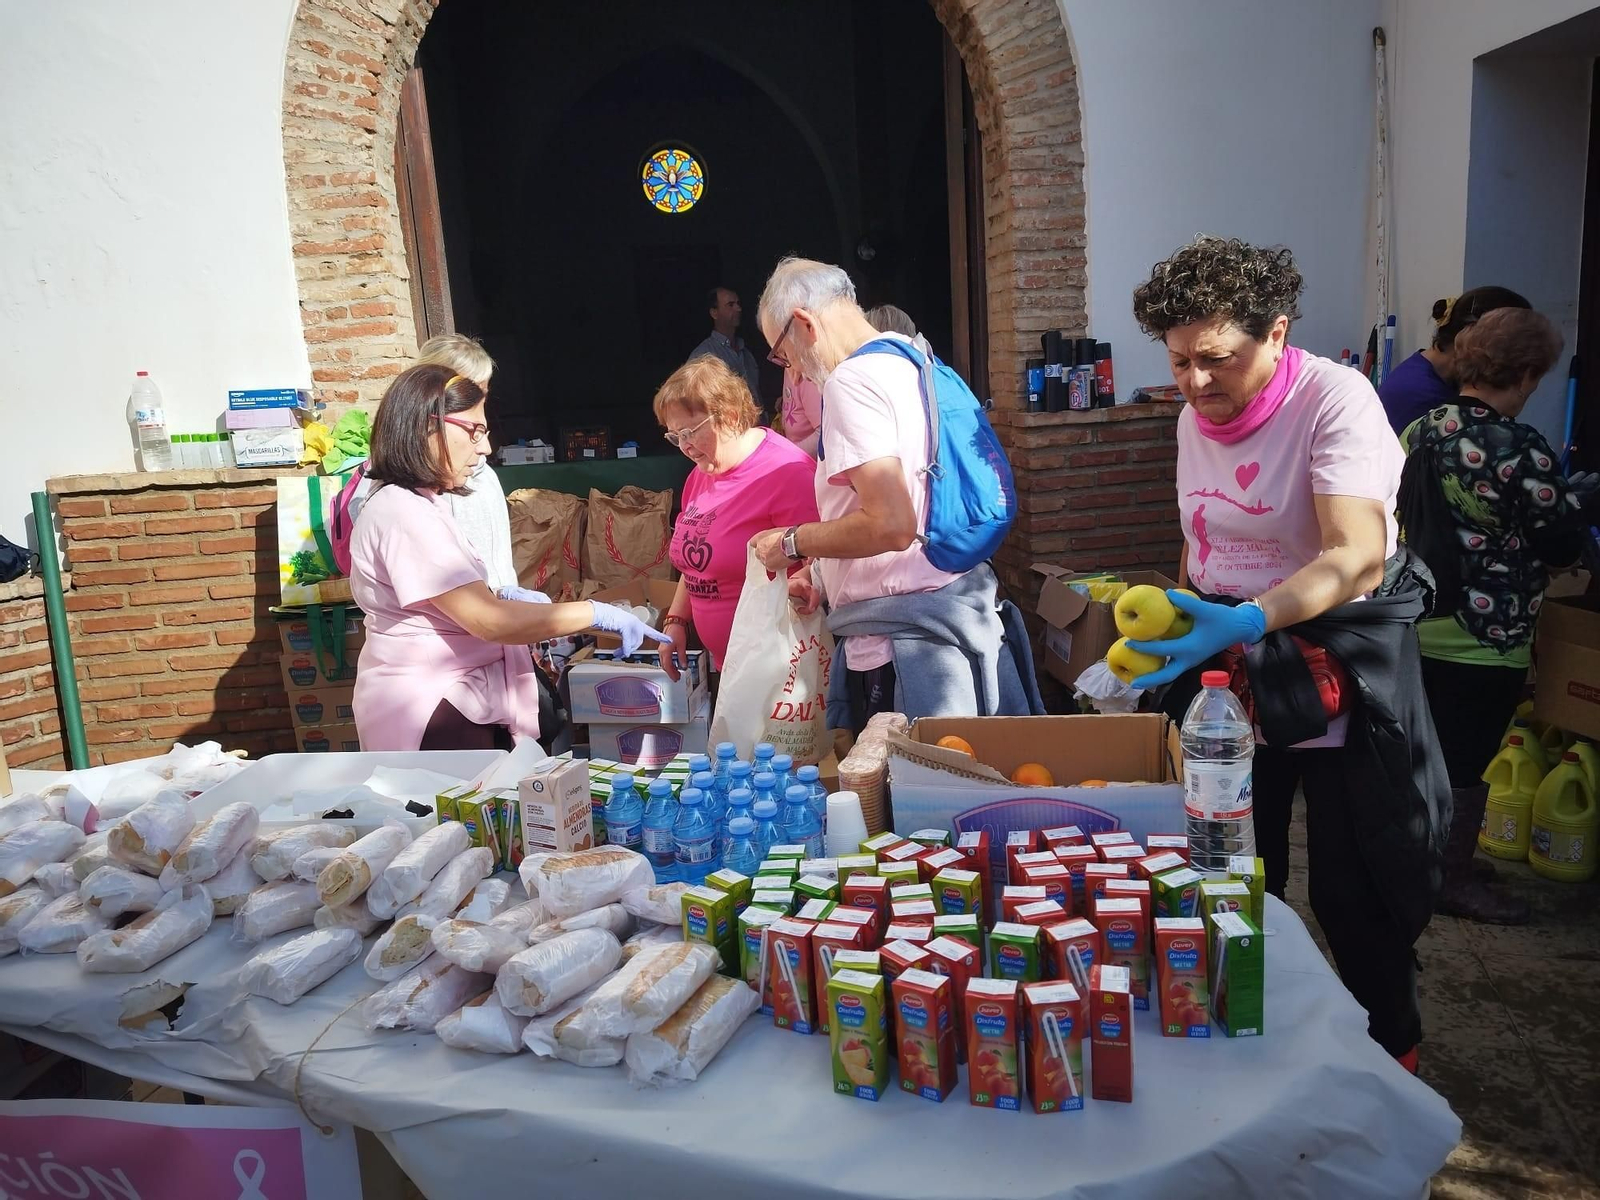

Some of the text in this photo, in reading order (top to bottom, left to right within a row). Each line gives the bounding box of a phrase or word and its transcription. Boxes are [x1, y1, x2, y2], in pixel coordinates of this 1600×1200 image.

[248, 446, 280, 454] MASCARILLAS
[1224, 562, 1263, 571] OCTUBRE
[564, 803, 592, 830] ALMENDRAS
[570, 820, 588, 836] CALCIO
[943, 898, 964, 906] Disfruta
[690, 908, 704, 916] Juver
[688, 916, 707, 926] Disfruta
[1000, 958, 1025, 966] Disfruta
[904, 997, 922, 1005] Juver
[838, 1007, 865, 1016] Disfruta
[902, 1007, 928, 1018] Disfruta
[976, 1018, 1006, 1026] Disfruta
[860, 1087, 873, 1095] FOOD
[924, 1088, 937, 1096] FOOD
